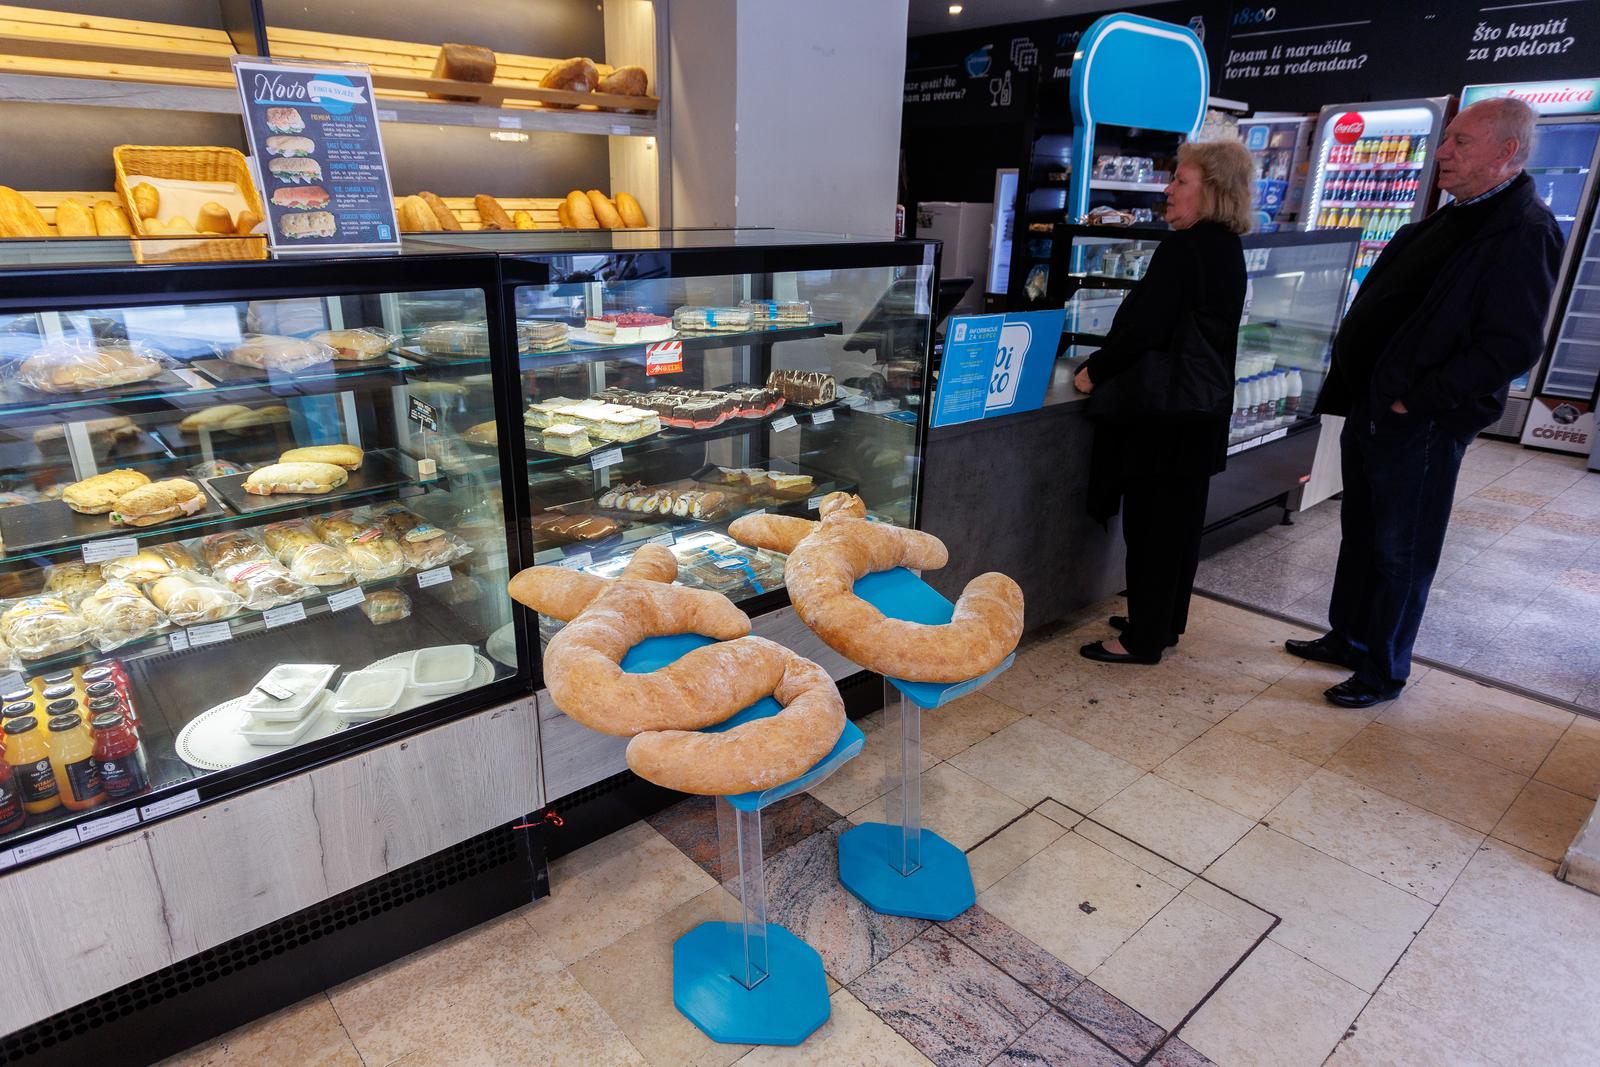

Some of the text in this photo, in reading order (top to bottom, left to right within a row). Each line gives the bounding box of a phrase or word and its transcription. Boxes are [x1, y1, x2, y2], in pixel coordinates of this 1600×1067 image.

[1233, 7, 1276, 25] 18:00
[1472, 17, 1568, 42] Što kupiti
[1227, 39, 1352, 66] Jesam li naručila
[1466, 36, 1576, 62] za poklon?
[1225, 65, 1260, 80] tortu
[1263, 66, 1281, 77] za
[254, 73, 306, 102] Novo
[922, 92, 932, 101] za
[933, 88, 967, 101] večeru?
[968, 333, 977, 341] ZA
[1532, 427, 1588, 444] COFFEE
